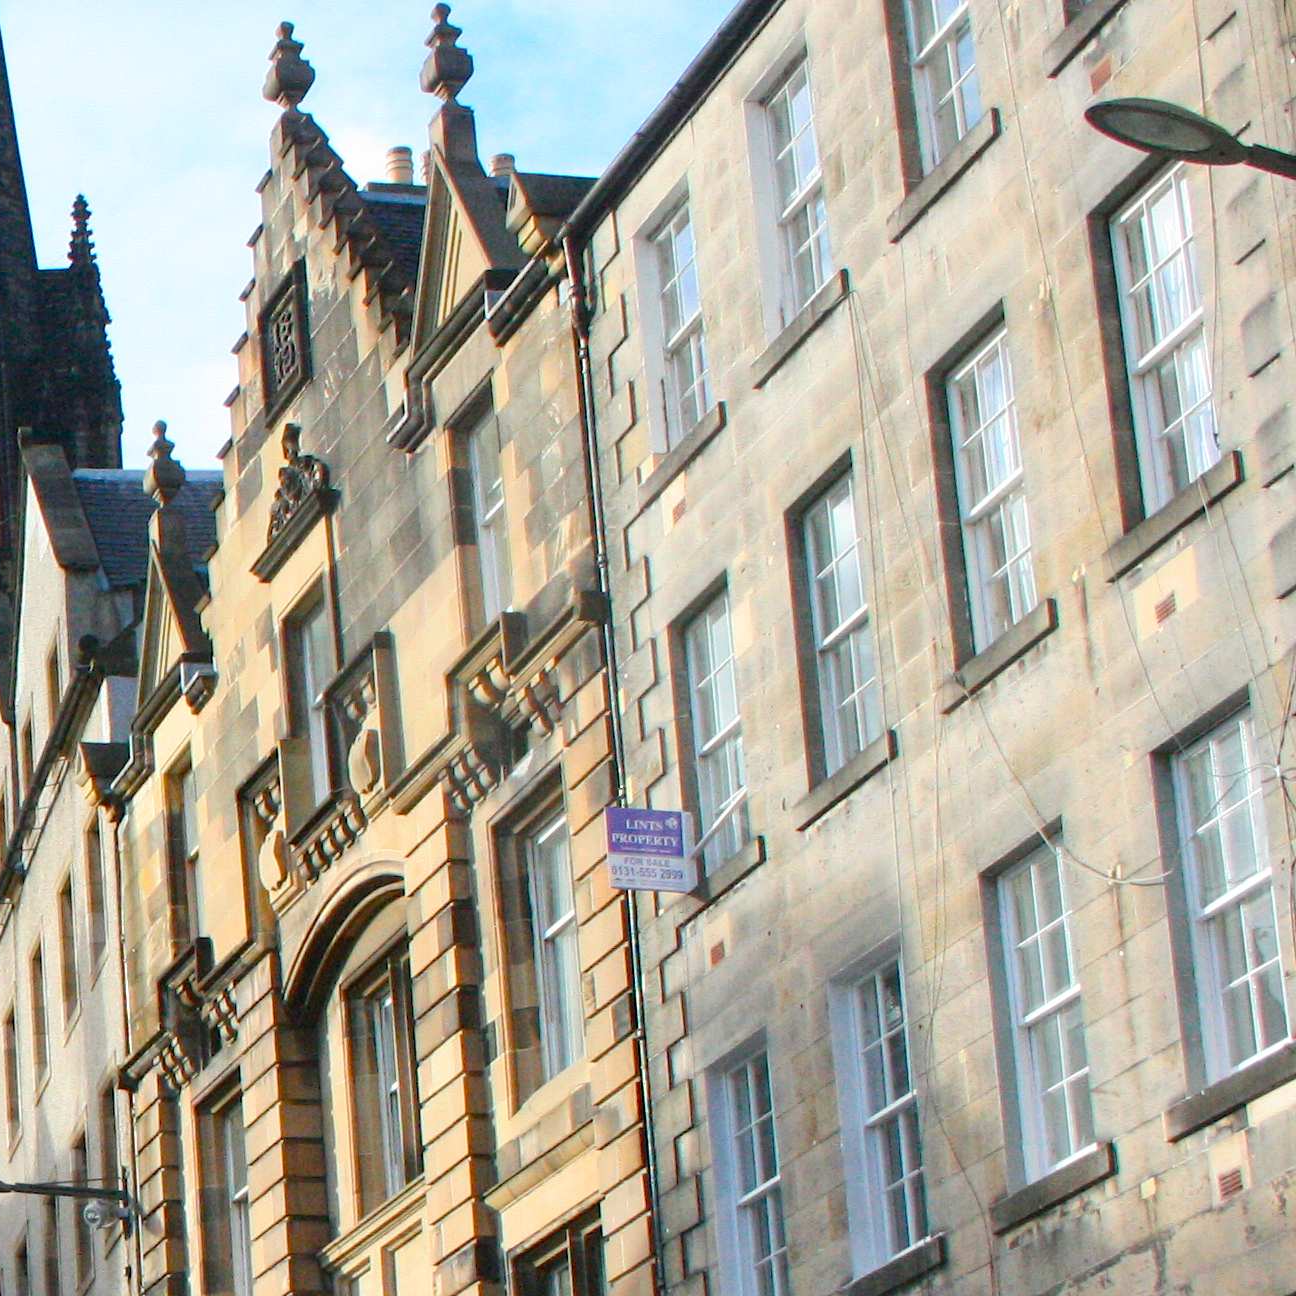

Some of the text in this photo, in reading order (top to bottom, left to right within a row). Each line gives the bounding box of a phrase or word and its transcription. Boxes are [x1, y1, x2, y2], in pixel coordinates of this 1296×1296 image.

[625, 818, 664, 831] LINTS
[611, 832, 679, 847] PROPERTY
[623, 856, 671, 867] FOR SALE
